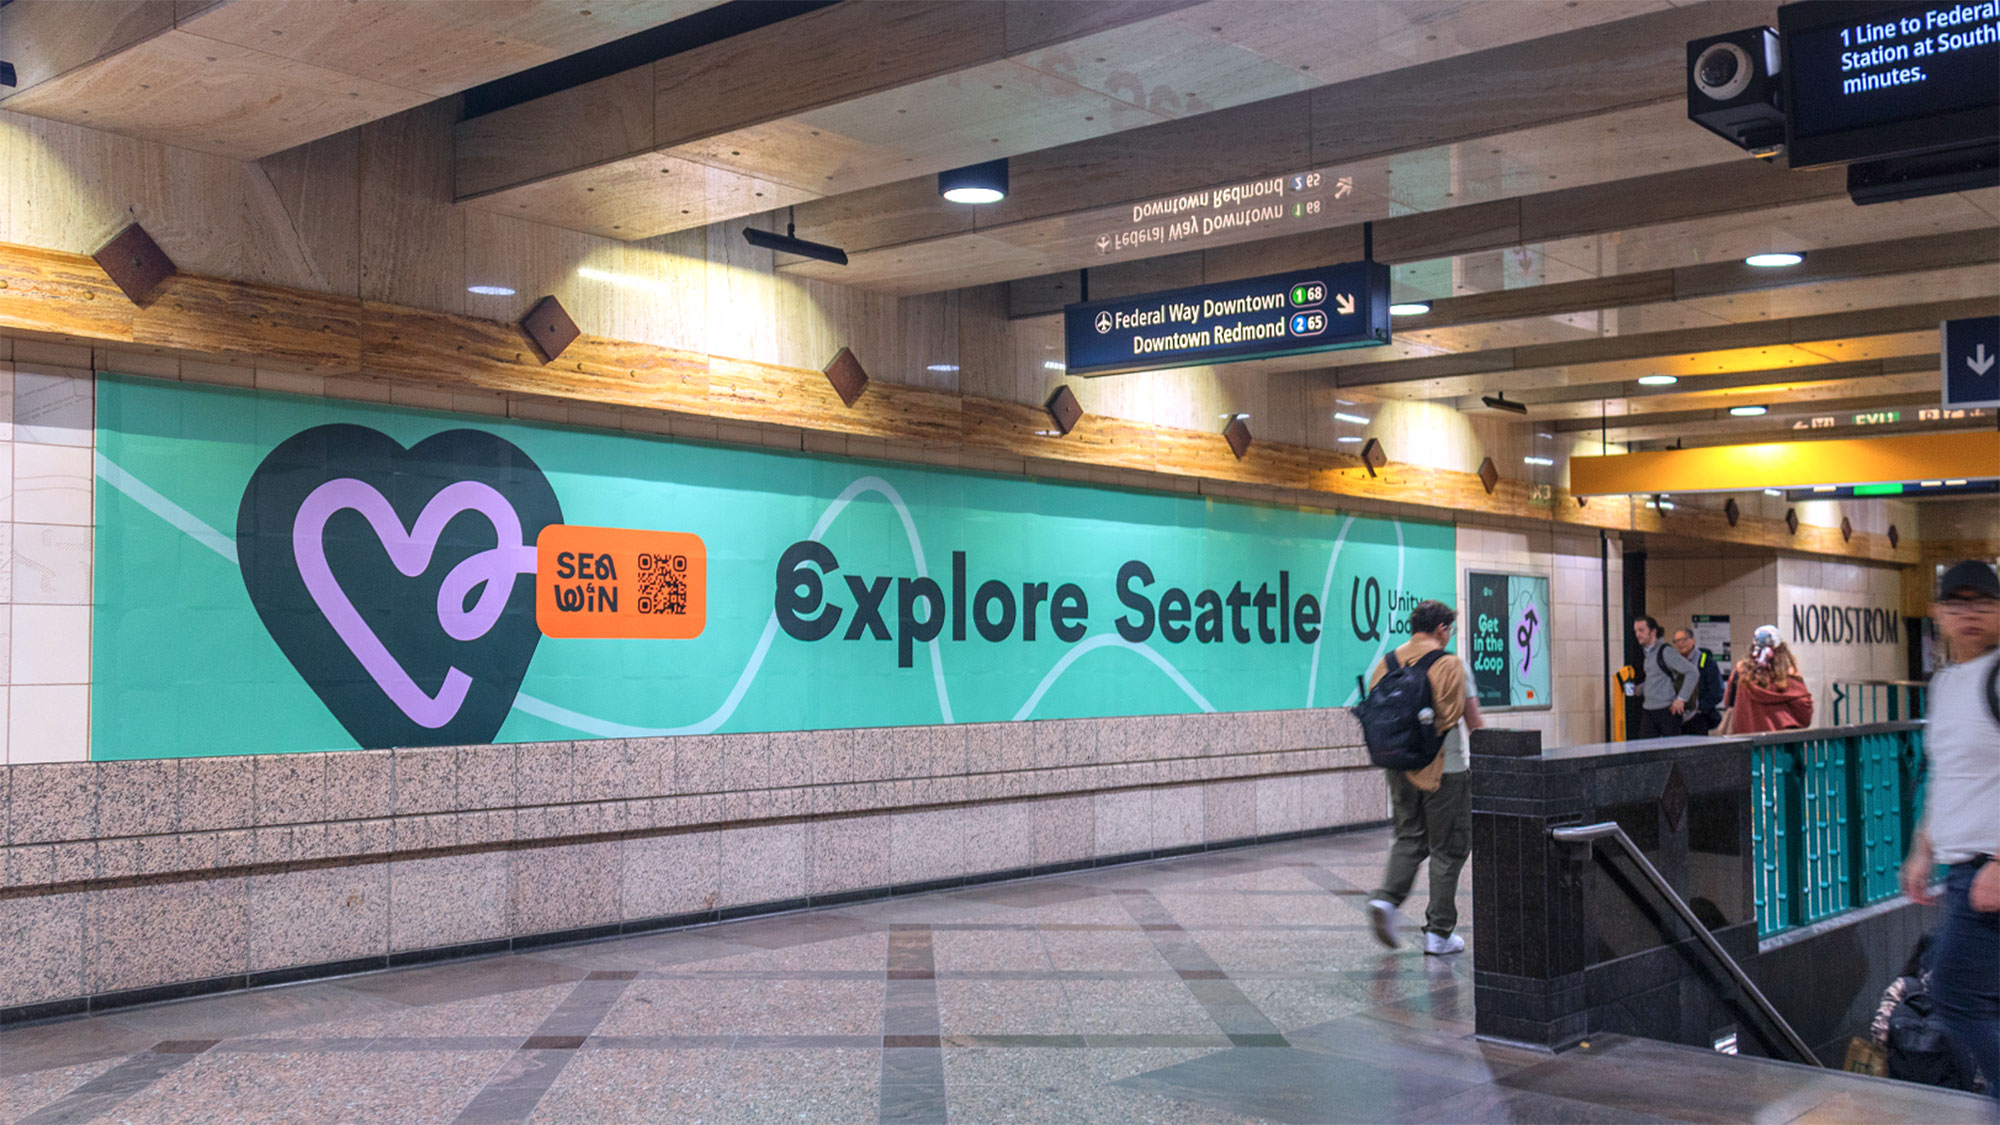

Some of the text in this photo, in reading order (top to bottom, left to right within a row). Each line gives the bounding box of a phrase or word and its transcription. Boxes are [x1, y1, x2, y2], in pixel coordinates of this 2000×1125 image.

[1840, 0, 2000, 47] 1 Line to Federal
[1841, 45, 1907, 71] Station
[1913, 38, 1934, 57] at
[1843, 66, 1927, 95] minutes.
[1115, 286, 1322, 330] Federal Way Downtown 1 68
[1134, 315, 1322, 354] Downtown Redmond 2 65
[556, 551, 618, 580] SEA
[775, 540, 1322, 668] Explore Seattle
[1478, 613, 1499, 636] Get
[1792, 603, 1899, 644] NORDSTROM
[1474, 633, 1504, 651] in the
[1474, 652, 1504, 676] Loop
